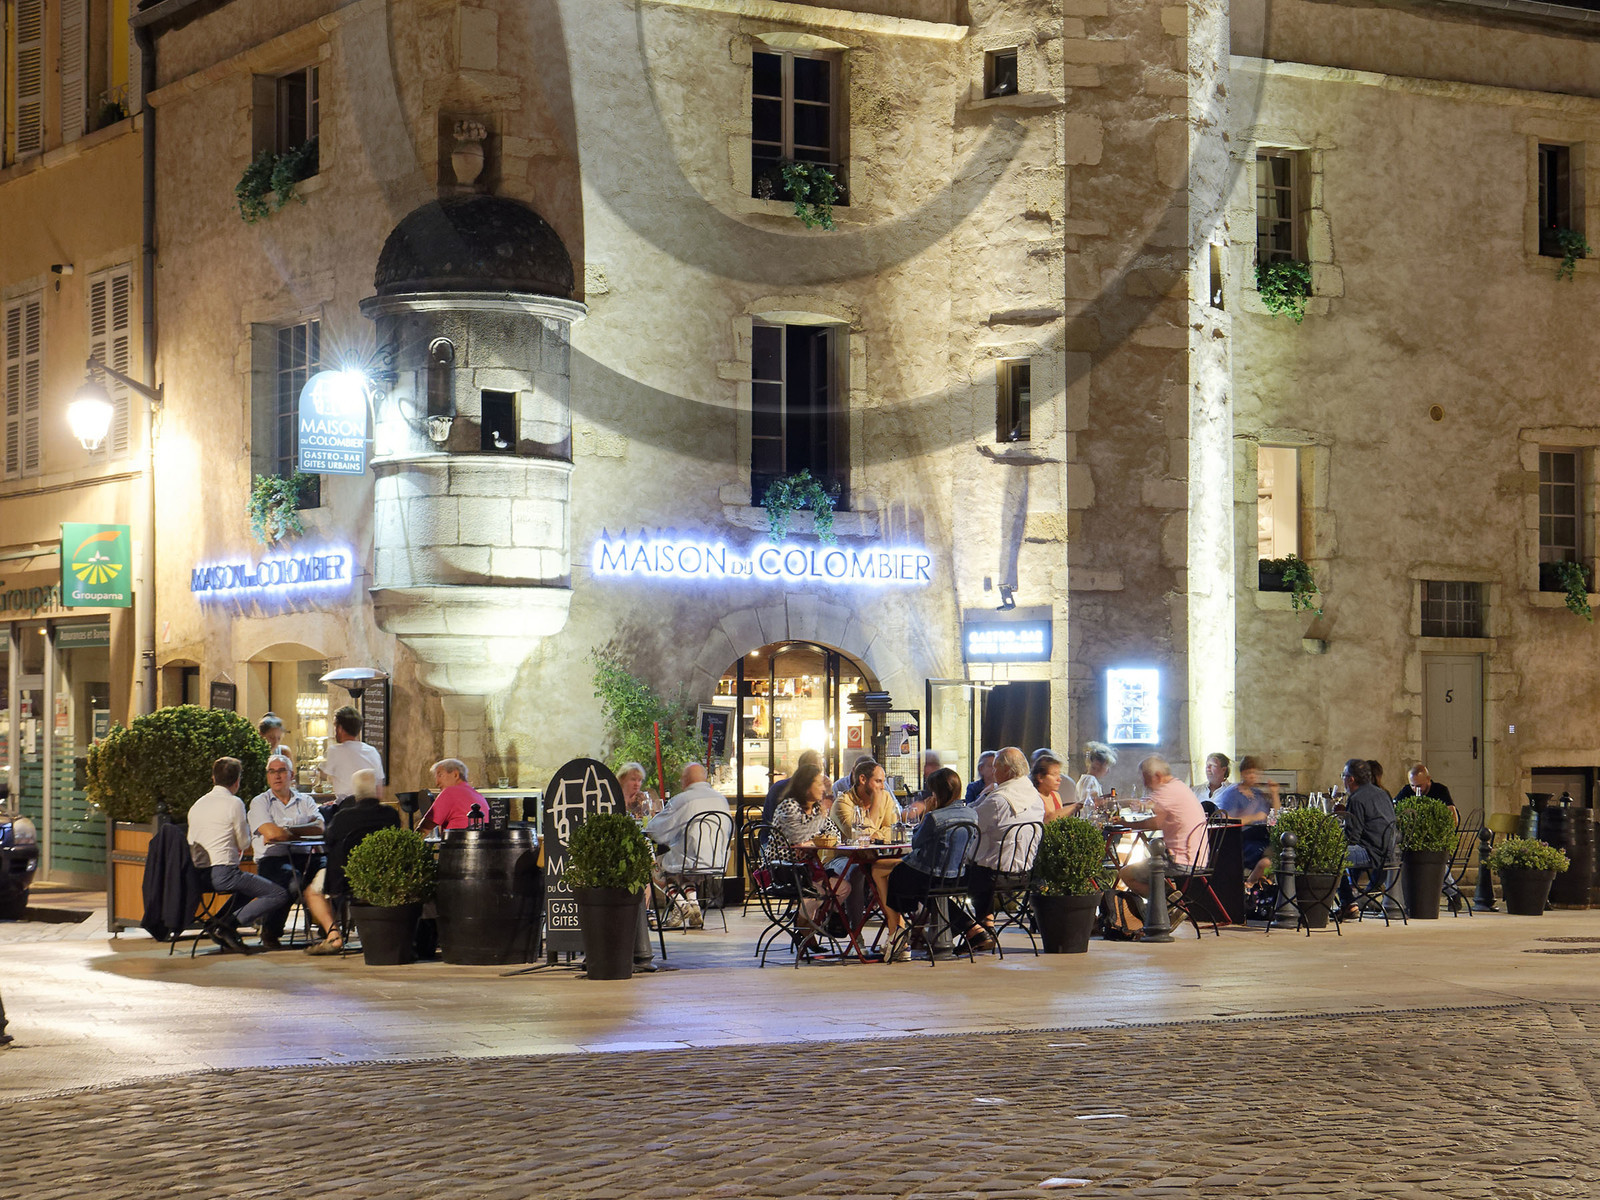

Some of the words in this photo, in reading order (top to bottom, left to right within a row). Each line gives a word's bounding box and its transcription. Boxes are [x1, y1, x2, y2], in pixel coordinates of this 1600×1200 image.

[301, 418, 364, 436] MAISON
[308, 435, 364, 448] COLOMBIER
[303, 451, 360, 461] GASTRO-BAR
[303, 461, 326, 469] GITES
[327, 462, 360, 470] URBAINS
[600, 543, 726, 574] MAISON
[731, 561, 753, 576] DU
[759, 548, 931, 580] COLOMBIER
[191, 565, 246, 592] MAISON
[257, 555, 345, 587] COLOMBIER
[71, 590, 124, 601] Groupama
[1445, 689, 1453, 703] 5
[552, 915, 579, 926] GITES
